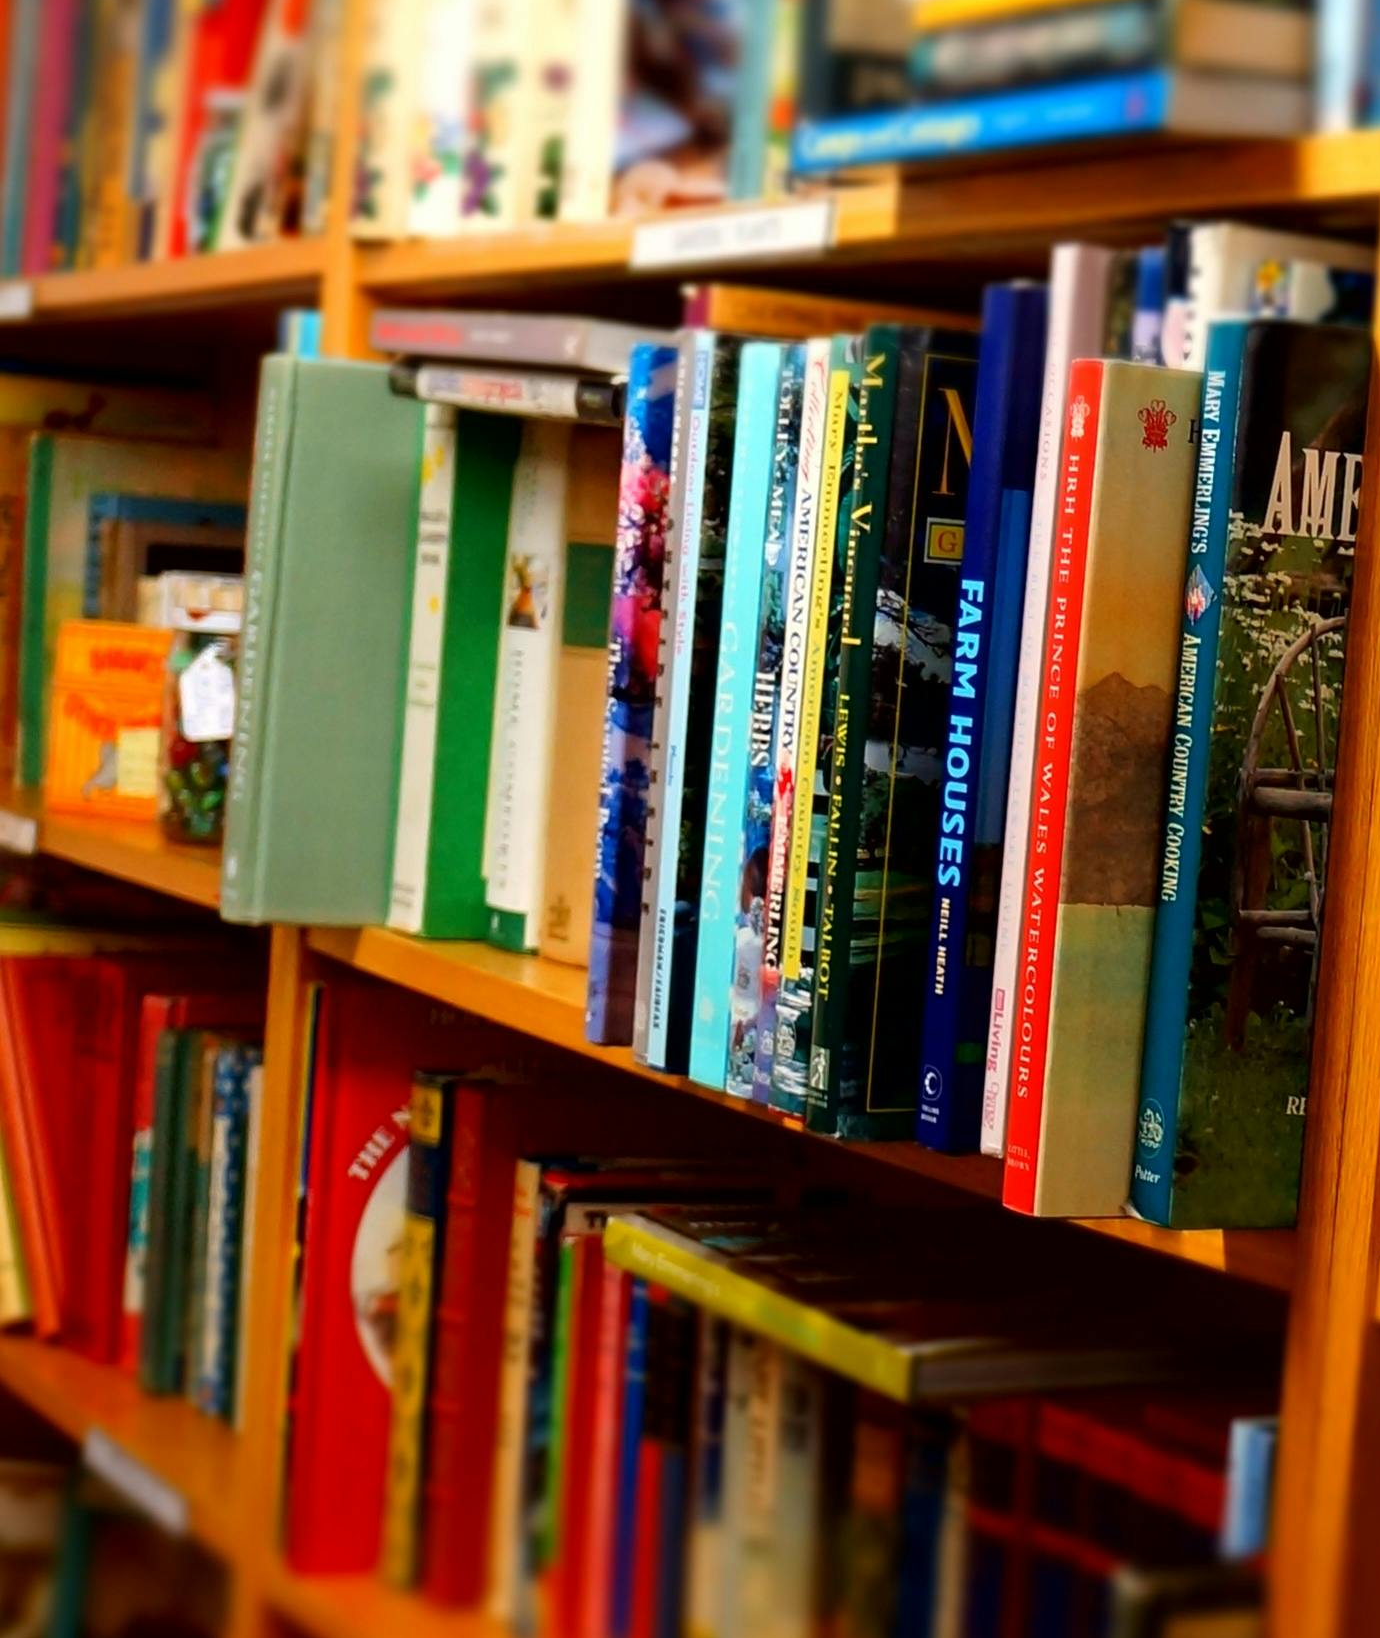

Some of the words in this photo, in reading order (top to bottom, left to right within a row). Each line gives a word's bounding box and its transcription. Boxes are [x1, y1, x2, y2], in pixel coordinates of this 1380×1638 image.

[828, 390, 844, 456] Mary
[854, 351, 887, 492] Martha's
[1203, 370, 1226, 423] MARY
[1065, 454, 1080, 516] HRH
[1190, 427, 1221, 555] EMMERLING'S
[787, 491, 812, 627] AMERICAN
[813, 463, 838, 630] Emmerling's
[841, 503, 873, 647] Vineyard
[1058, 527, 1074, 584] THE
[952, 578, 985, 700] FARM
[1047, 596, 1068, 700] PRINCE
[1175, 632, 1202, 729] AMERICAN
[751, 671, 776, 768] HERBS
[778, 639, 801, 756] COUNTRY
[800, 641, 821, 766] American
[835, 693, 850, 768] LEWIS
[1044, 713, 1058, 750] OF
[702, 620, 740, 920] GARDENING
[937, 713, 973, 888] HOUSES
[1035, 763, 1054, 855] WALES
[1167, 733, 1193, 819] COUNTRY
[795, 777, 810, 878] Country
[827, 793, 843, 878] FALLIN
[1160, 822, 1185, 902] COOKING
[764, 813, 788, 972] EMMERLING
[938, 897, 951, 942] NEILL
[817, 902, 836, 1002] TALBOT
[934, 945, 947, 996] HEATH
[1016, 867, 1046, 1099] WATERCOLOURS
[986, 1011, 1005, 1074] Living
[346, 1124, 397, 1181] THE
[1135, 1164, 1161, 1184] Potter
